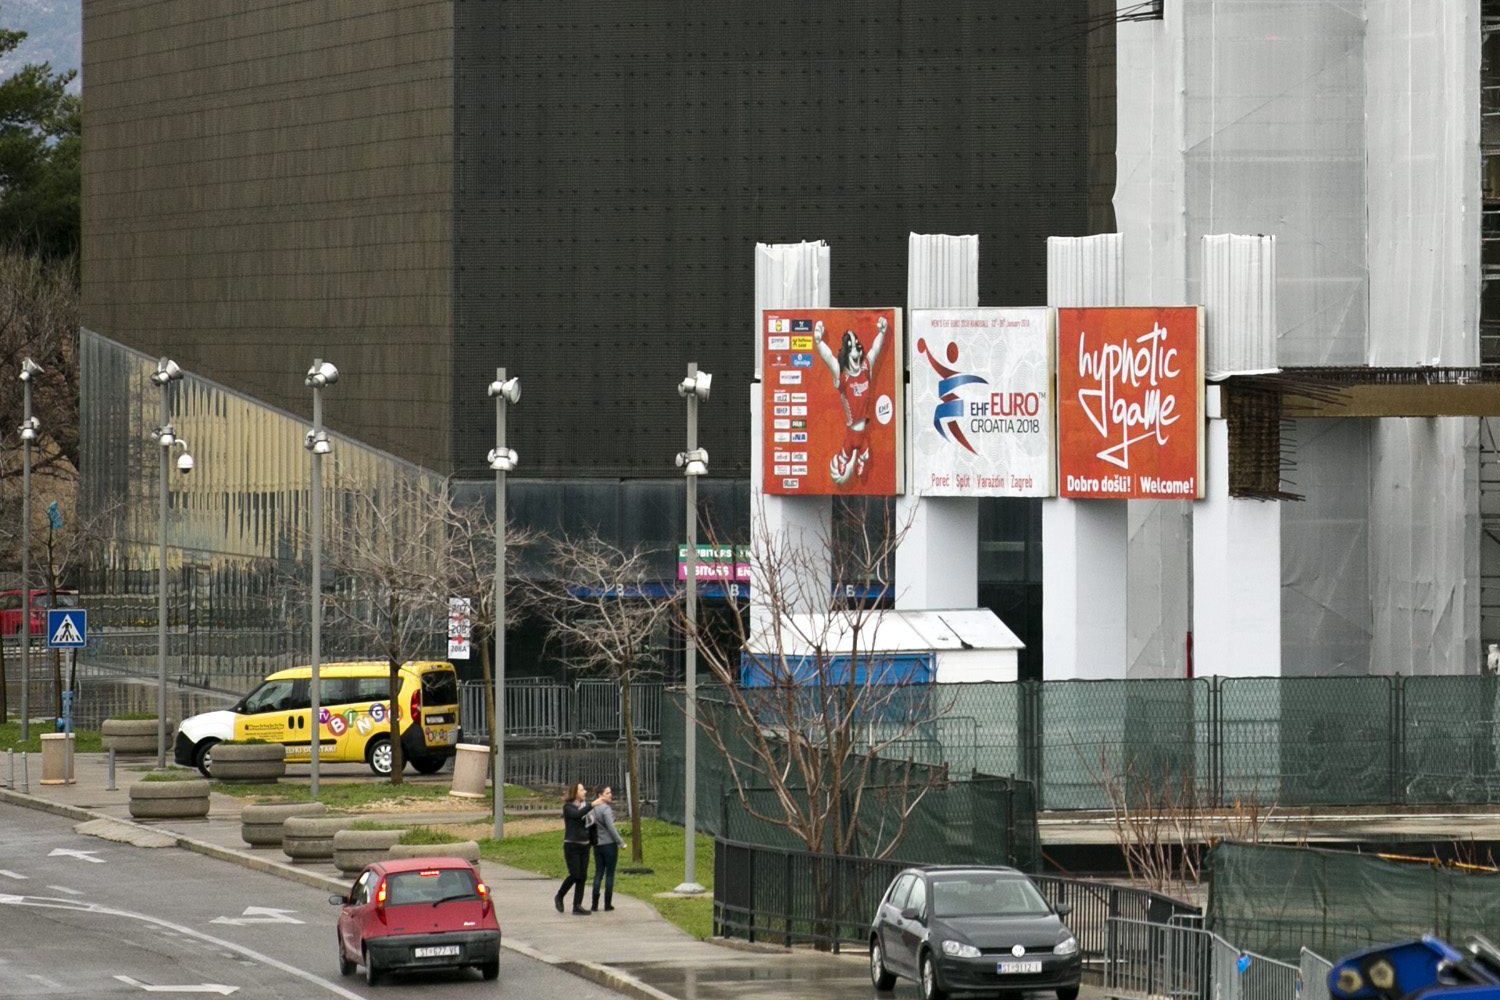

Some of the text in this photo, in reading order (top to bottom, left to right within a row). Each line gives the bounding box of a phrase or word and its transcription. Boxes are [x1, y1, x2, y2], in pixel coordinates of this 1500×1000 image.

[1079, 322, 1181, 438] hypnotic
[970, 402, 989, 416] EHF
[991, 392, 1039, 416] EURO
[970, 419, 1040, 433] CROATIA 2018
[1096, 389, 1181, 470] game
[931, 473, 950, 488] Poreč
[956, 474, 971, 491] Split
[976, 474, 1005, 489] Varaždin
[1011, 474, 1033, 492] Zagreb
[1067, 474, 1131, 492] Dobro došli!
[1140, 476, 1194, 494] Welcome!
[319, 712, 330, 721] TV
[330, 706, 401, 734] BING
